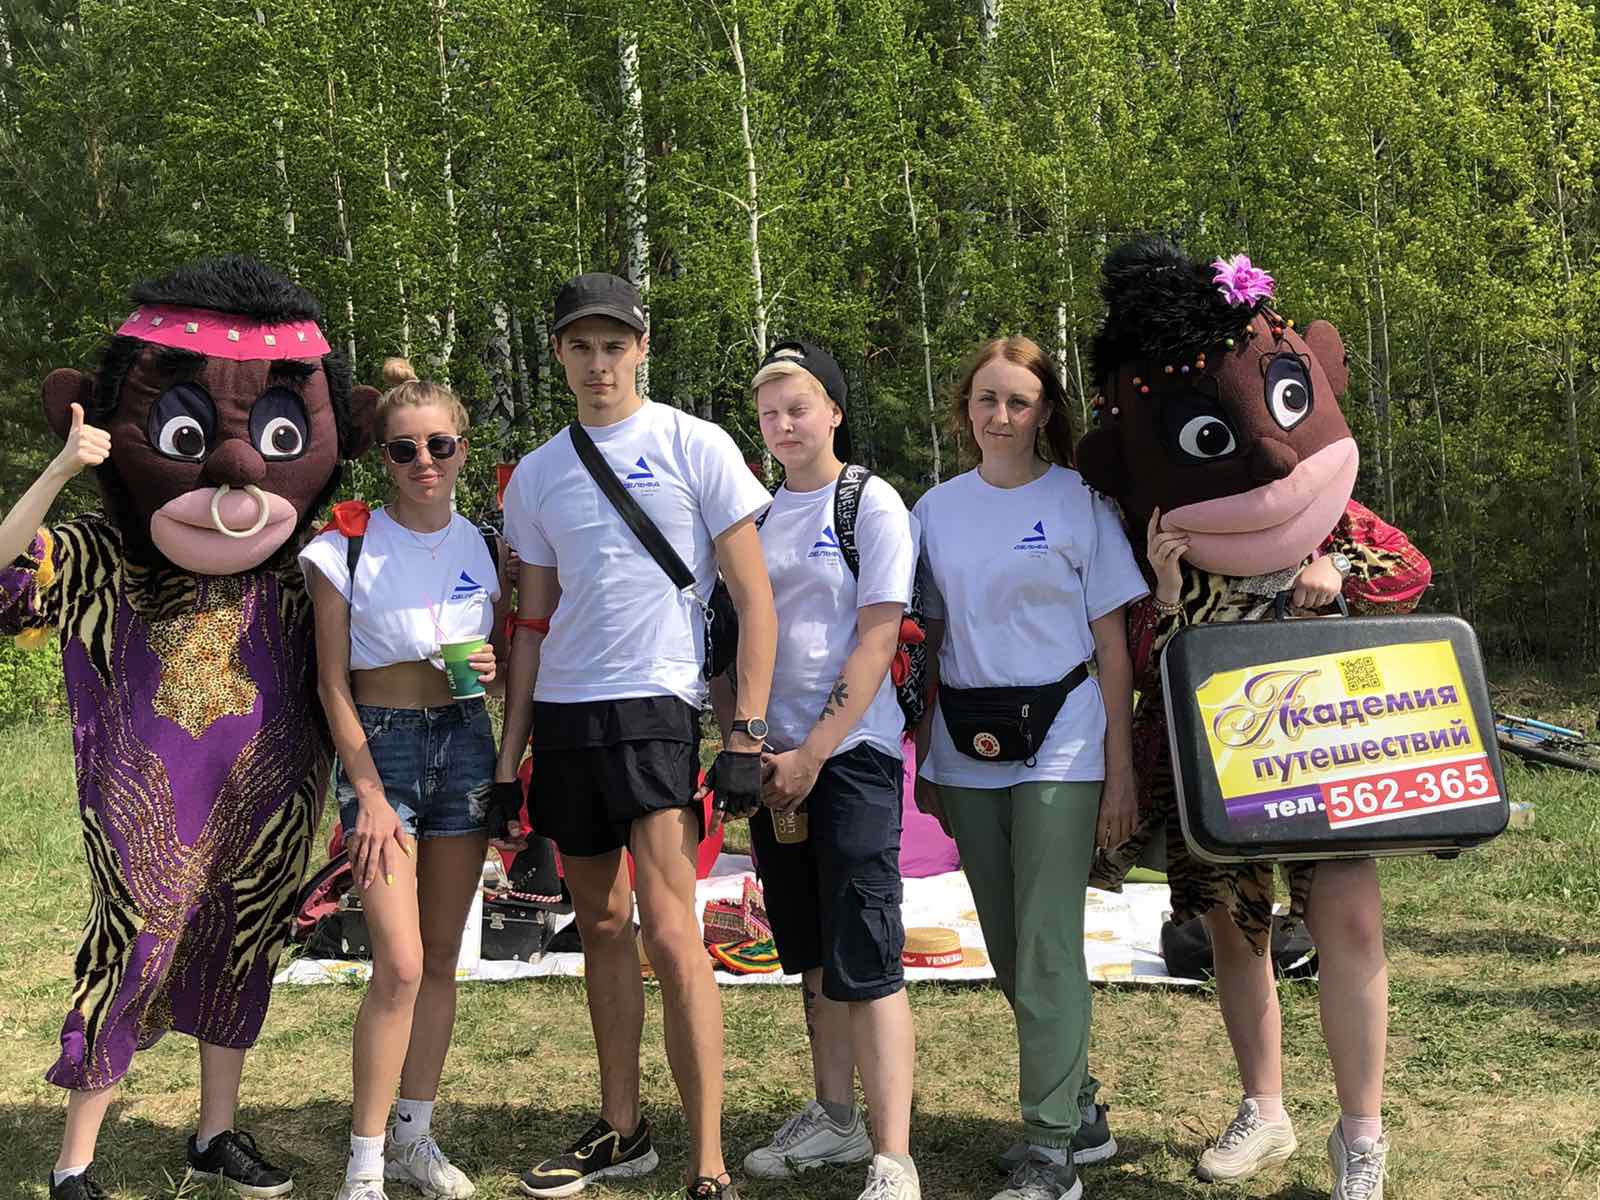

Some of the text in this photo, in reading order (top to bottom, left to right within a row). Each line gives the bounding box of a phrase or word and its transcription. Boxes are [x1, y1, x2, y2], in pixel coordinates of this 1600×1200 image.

[1213, 669, 1459, 748] Академия
[1252, 720, 1472, 783] путешествий
[1263, 764, 1489, 819] тел. 562-365
